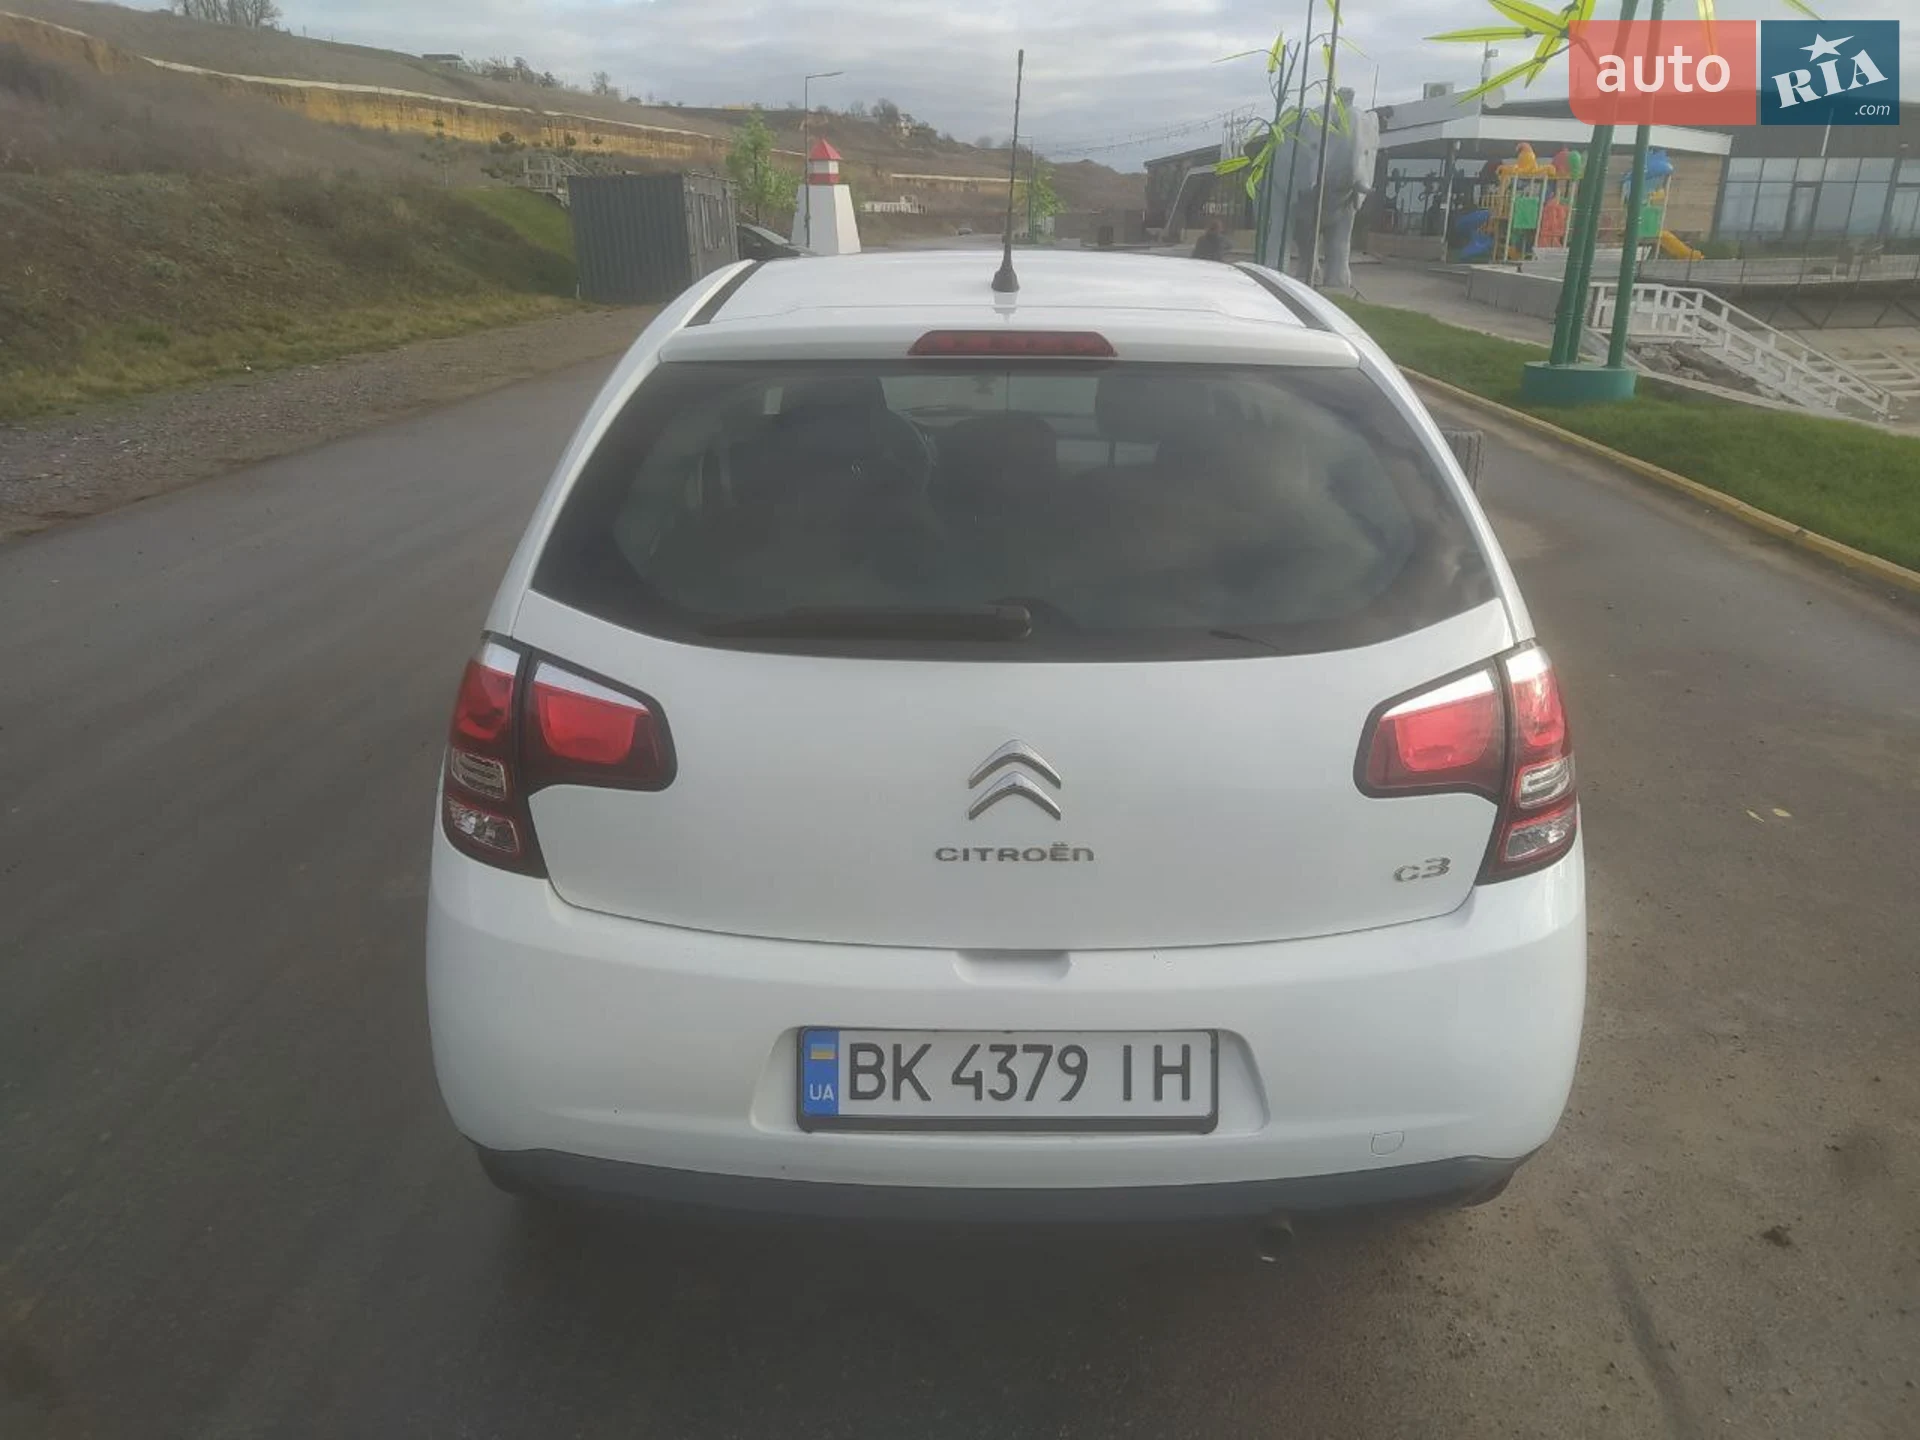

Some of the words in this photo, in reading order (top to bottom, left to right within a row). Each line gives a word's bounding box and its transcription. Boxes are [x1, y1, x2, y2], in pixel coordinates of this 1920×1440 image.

[849, 1043, 932, 1101] BK
[951, 1044, 1088, 1101] 4379
[1123, 1044, 1191, 1102] IH
[809, 1083, 835, 1101] UA
